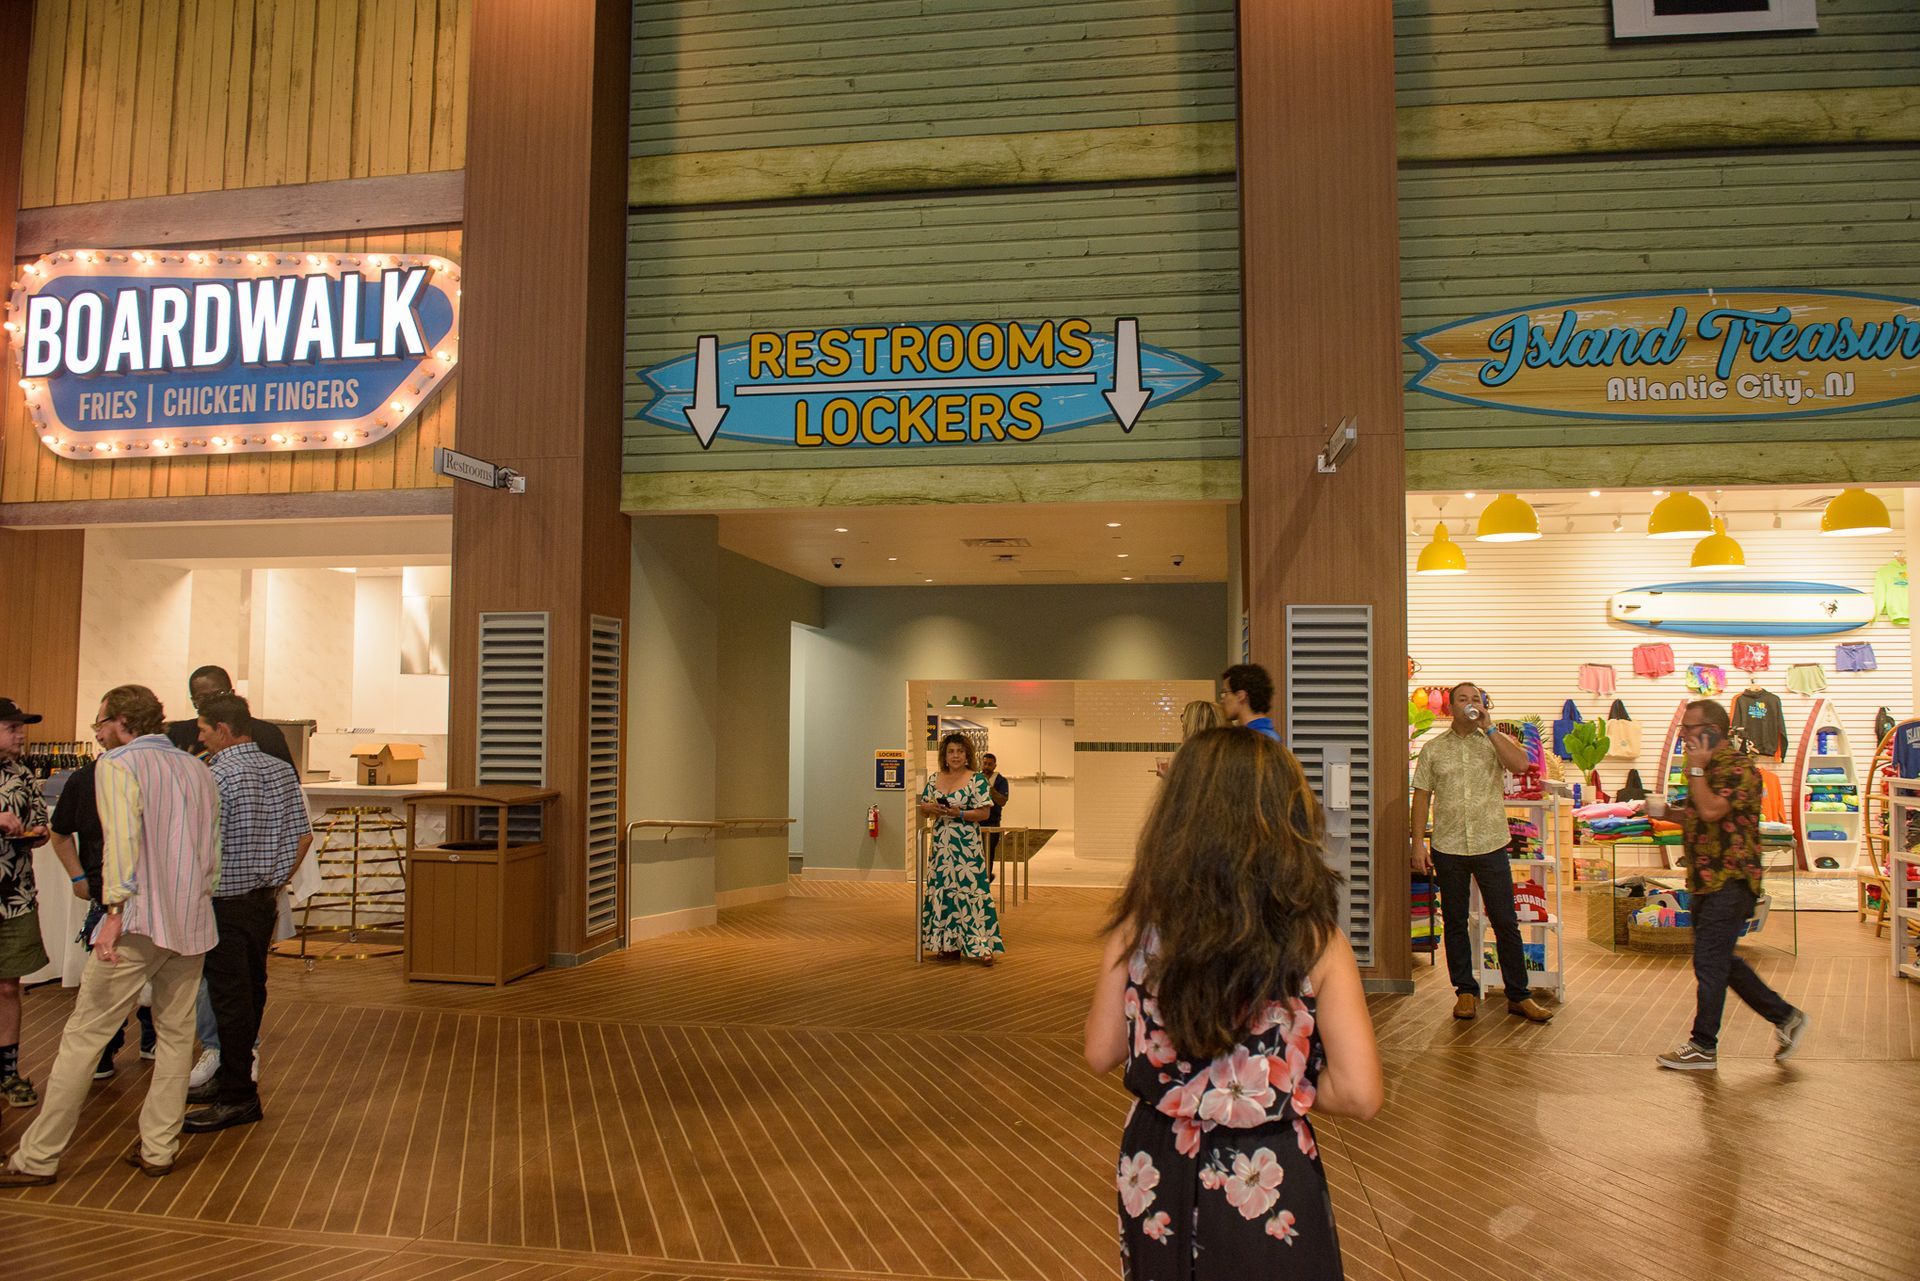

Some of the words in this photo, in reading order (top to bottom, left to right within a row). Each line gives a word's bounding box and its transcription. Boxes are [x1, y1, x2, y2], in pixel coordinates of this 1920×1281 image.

[22, 267, 431, 378] BOARDWALK
[748, 318, 1094, 379] RESTROOMS
[1478, 306, 1688, 387] Island
[78, 390, 138, 422] FRIES
[163, 384, 257, 417] CHICKEN
[264, 377, 359, 413] FINGERS
[1606, 375, 1729, 402] Atlantic
[1825, 372, 1856, 398] NJ
[794, 391, 1044, 447] LOCKERS
[446, 452, 493, 482] Restrooms
